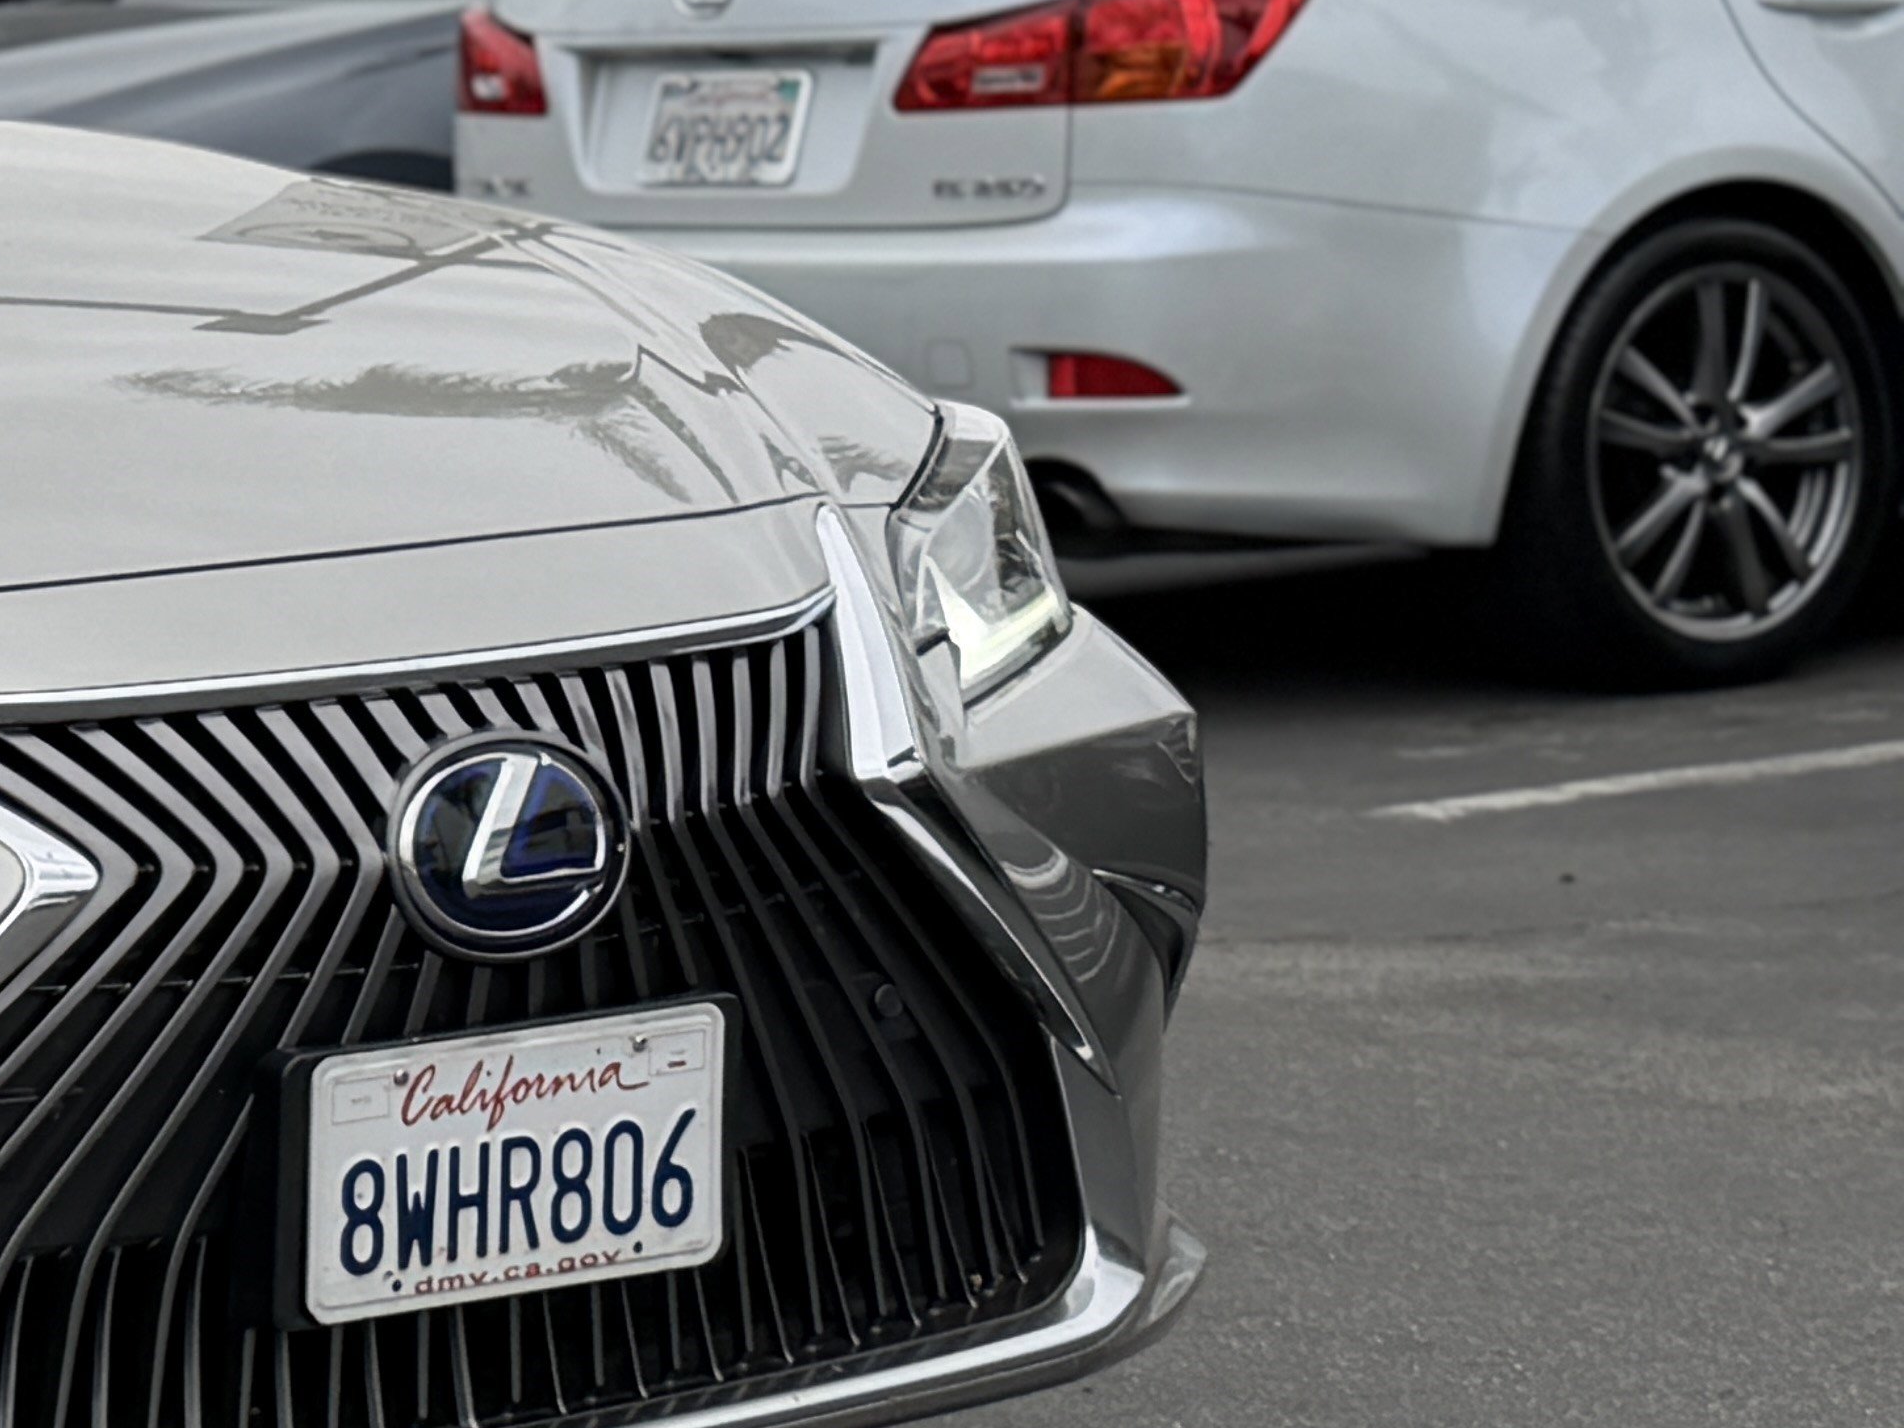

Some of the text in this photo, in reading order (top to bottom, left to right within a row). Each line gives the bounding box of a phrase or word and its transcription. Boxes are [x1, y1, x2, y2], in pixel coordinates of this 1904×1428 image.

[400, 1054, 649, 1131] California
[340, 1108, 697, 1276] 8WHR806
[414, 1248, 624, 1295] dmv.ca.gov
